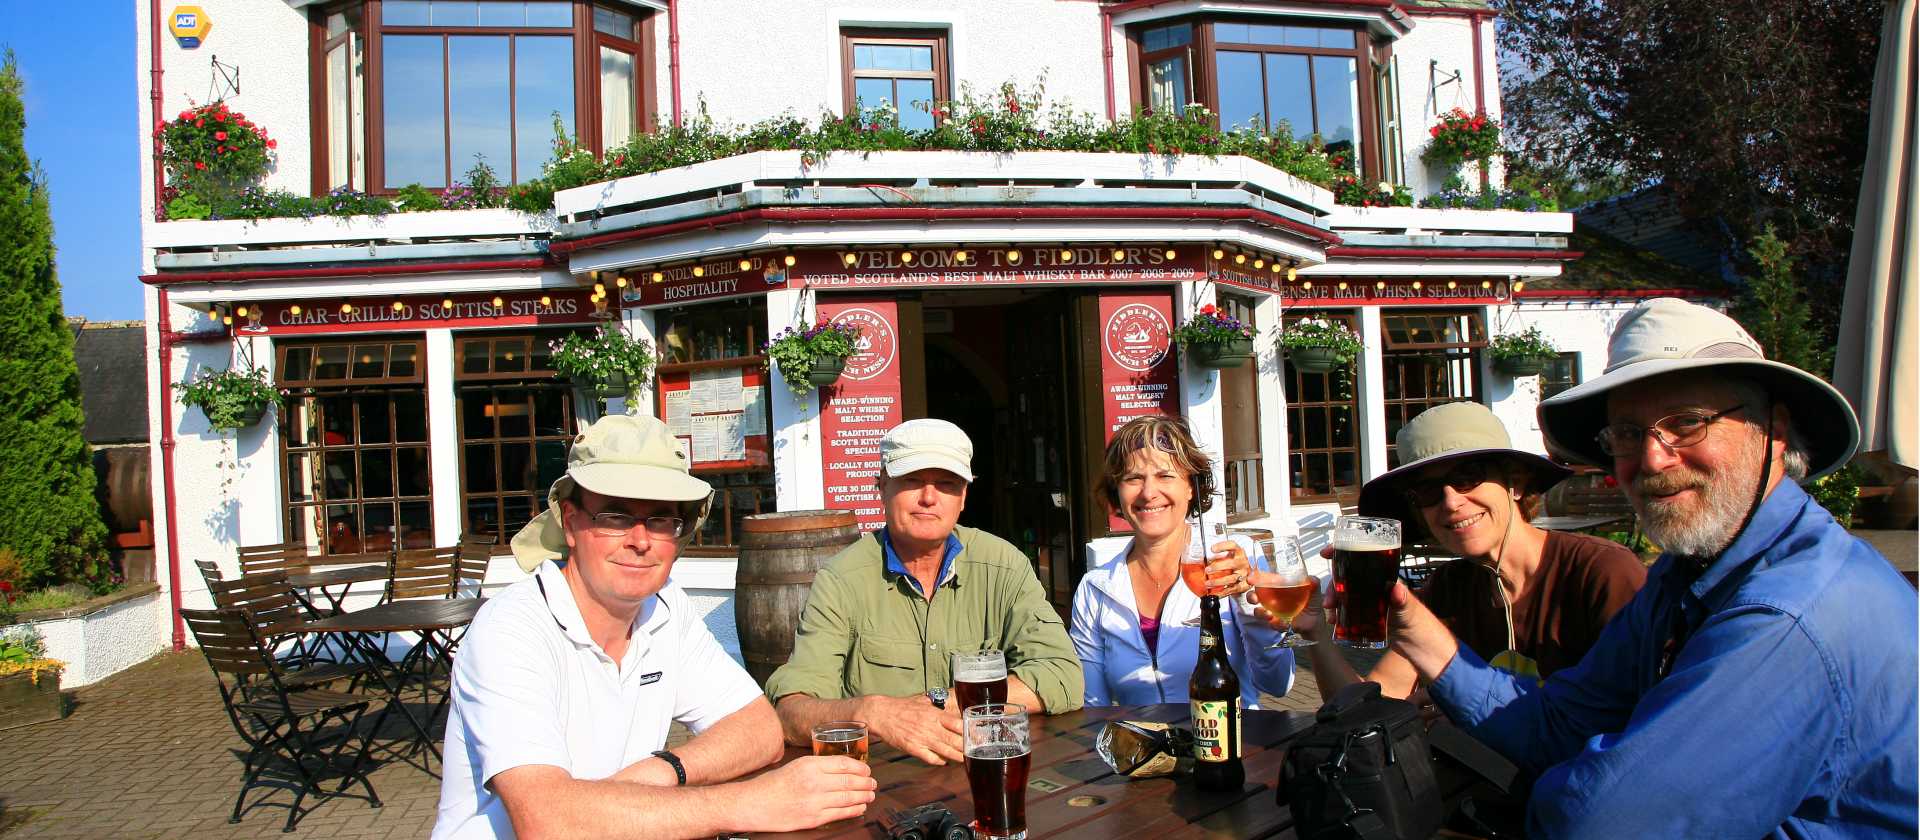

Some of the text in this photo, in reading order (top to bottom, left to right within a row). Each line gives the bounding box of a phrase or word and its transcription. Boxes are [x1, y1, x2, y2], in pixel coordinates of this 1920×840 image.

[177, 16, 195, 25] ADT
[836, 247, 1164, 269] WELCOME TO FIDDLER'S
[803, 274, 850, 285] VOTED
[854, 271, 939, 284] SCOTLAND'S
[944, 271, 977, 282] BEST
[982, 270, 1018, 281] MALT
[1022, 269, 1075, 281] WHISKY
[1080, 269, 1105, 279] BAR
[664, 279, 738, 299] HOSPITALITY
[1334, 285, 1368, 298] MALT
[1372, 284, 1422, 298] WHISKY
[1427, 284, 1493, 298] SELECTION
[280, 298, 577, 325] CHAR-GRILLED SCOTTISH STEAKS
[1110, 384, 1168, 393] AWARD-WINNING
[830, 396, 894, 406] AWARD-WINNING
[1115, 392, 1164, 401] MALT WHISKY
[835, 405, 889, 414] MALT WHISKY
[1120, 401, 1160, 409] SELECTION
[841, 414, 885, 423] SELECTION
[829, 461, 862, 470] LOCALLY
[828, 485, 848, 493] OVER
[835, 494, 874, 502] SCOTTISH
[854, 507, 880, 516] GUEST
[1193, 728, 1219, 738] OOD
